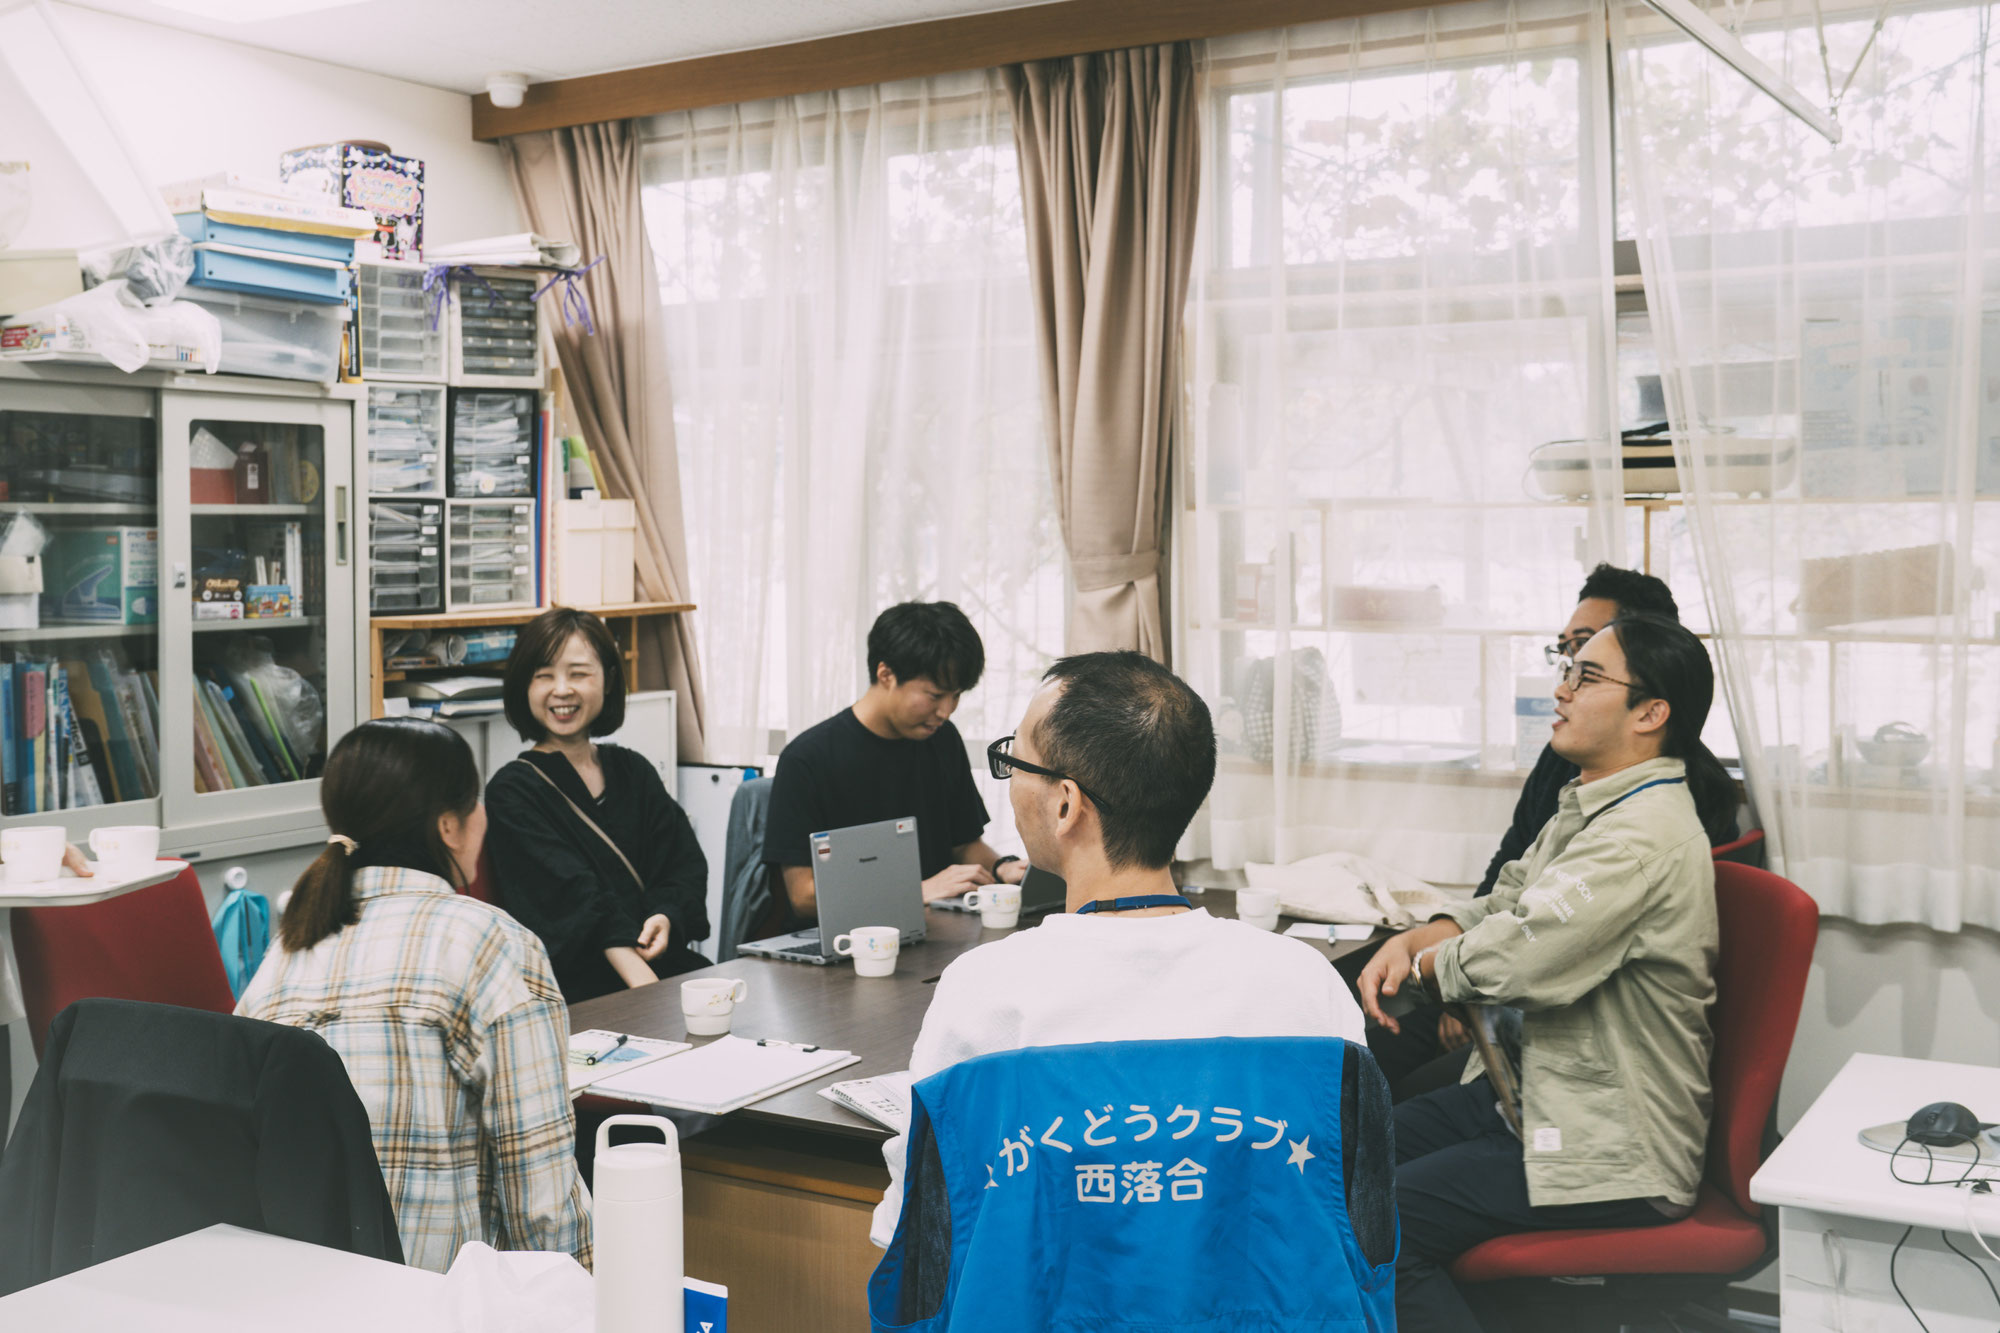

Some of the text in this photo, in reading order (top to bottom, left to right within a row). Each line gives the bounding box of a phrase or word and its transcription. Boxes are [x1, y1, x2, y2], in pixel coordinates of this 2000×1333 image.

[998, 1103, 1289, 1177] がくどうクラブ
[1074, 1157, 1208, 1205] 西落合
